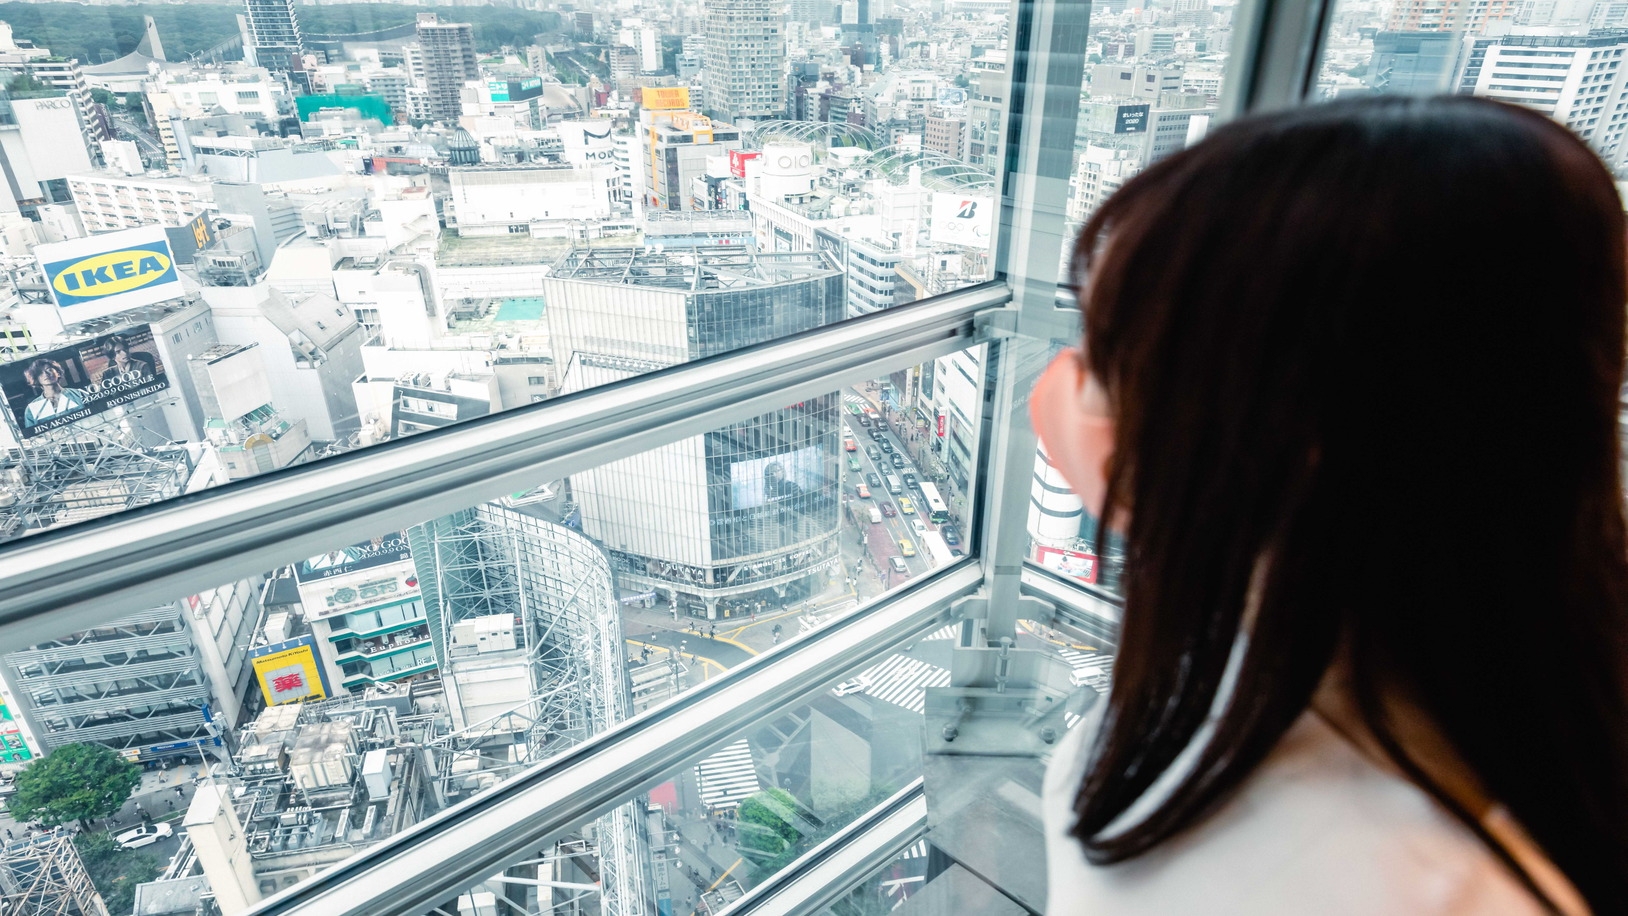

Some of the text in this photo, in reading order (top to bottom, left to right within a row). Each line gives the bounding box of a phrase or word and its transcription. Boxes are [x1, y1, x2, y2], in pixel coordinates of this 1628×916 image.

[34, 99, 71, 110] PARCO
[63, 256, 165, 291] IKEA
[78, 369, 141, 399] NO GOOD
[119, 381, 131, 393] ON
[132, 373, 156, 388] SALE
[106, 381, 166, 409] RYO NISHIKIDO
[34, 408, 92, 434] JIN AKANISHI
[381, 536, 411, 550] GOO
[660, 562, 703, 576] TSUTAYA
[807, 557, 839, 576] TSUTAYA
[370, 634, 430, 654] Euphoria
